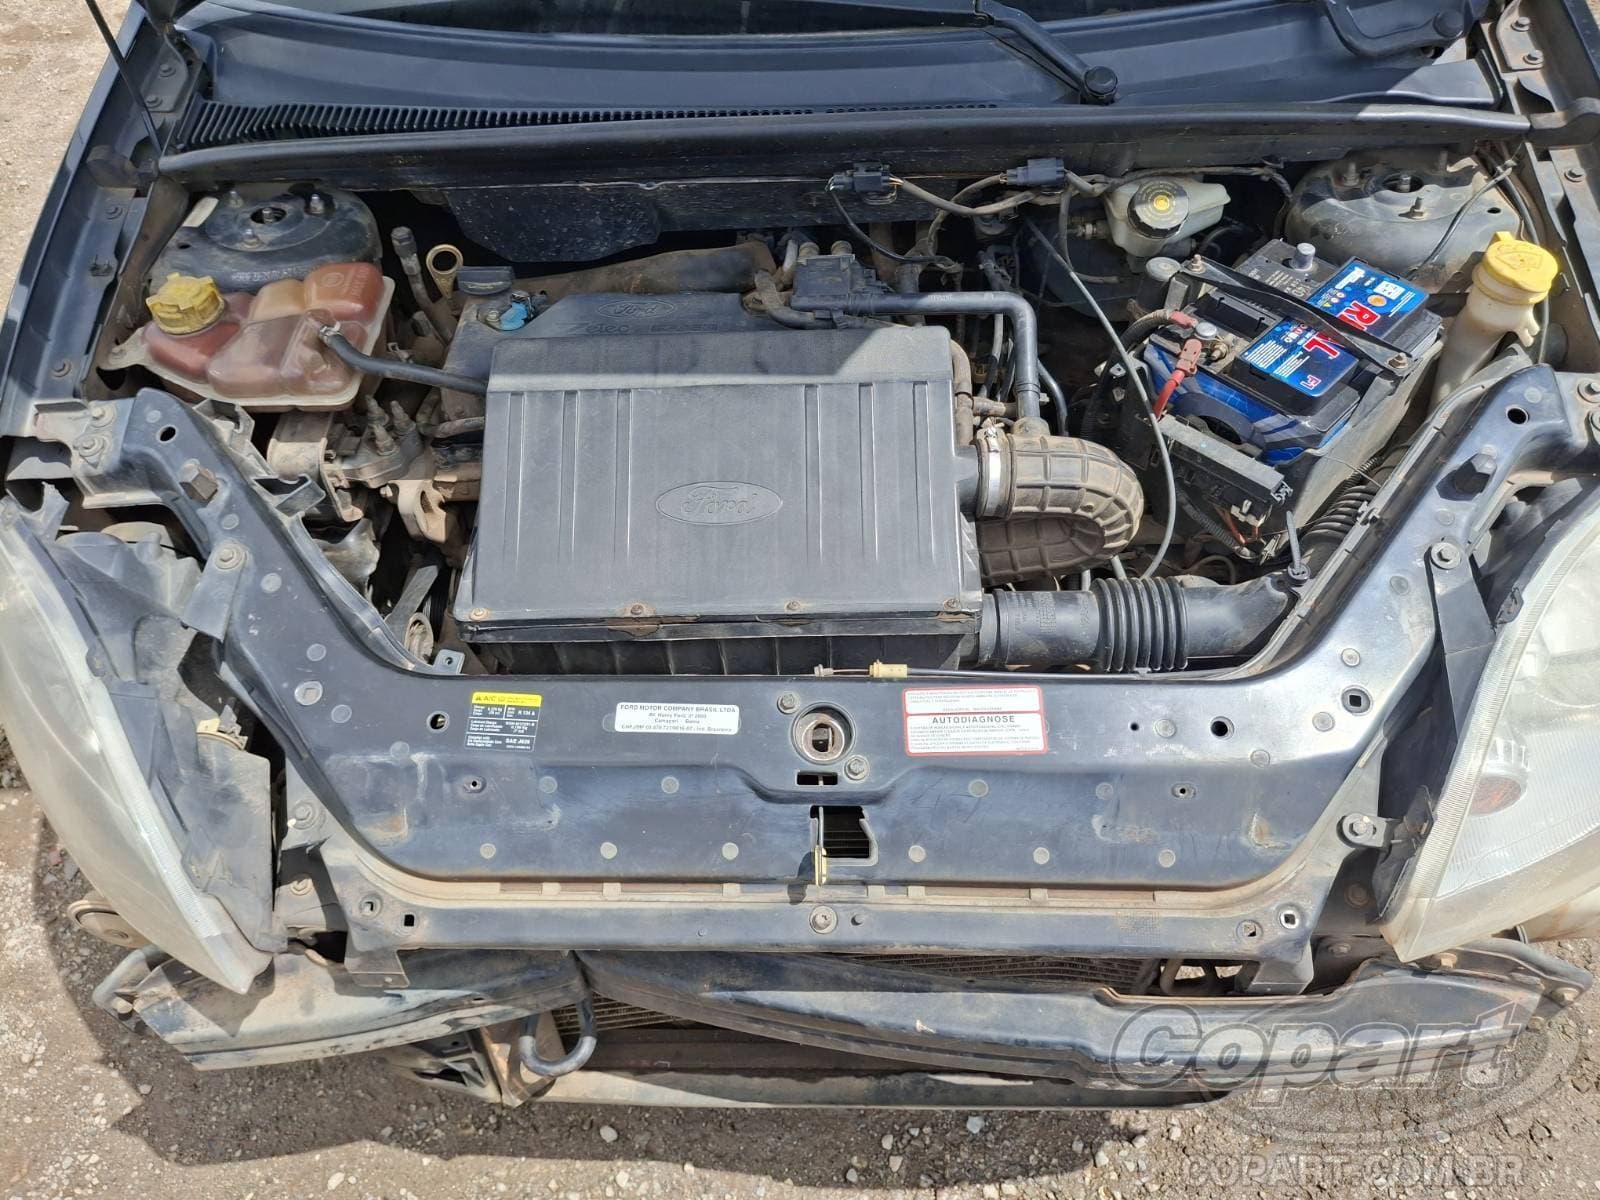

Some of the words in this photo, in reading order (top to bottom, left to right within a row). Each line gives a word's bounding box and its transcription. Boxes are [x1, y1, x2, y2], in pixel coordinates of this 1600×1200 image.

[614, 302, 657, 315] Ford
[1303, 300, 1381, 359] RL
[680, 485, 757, 514] Ford
[932, 715, 1016, 724] AUTODIAGNOSE
